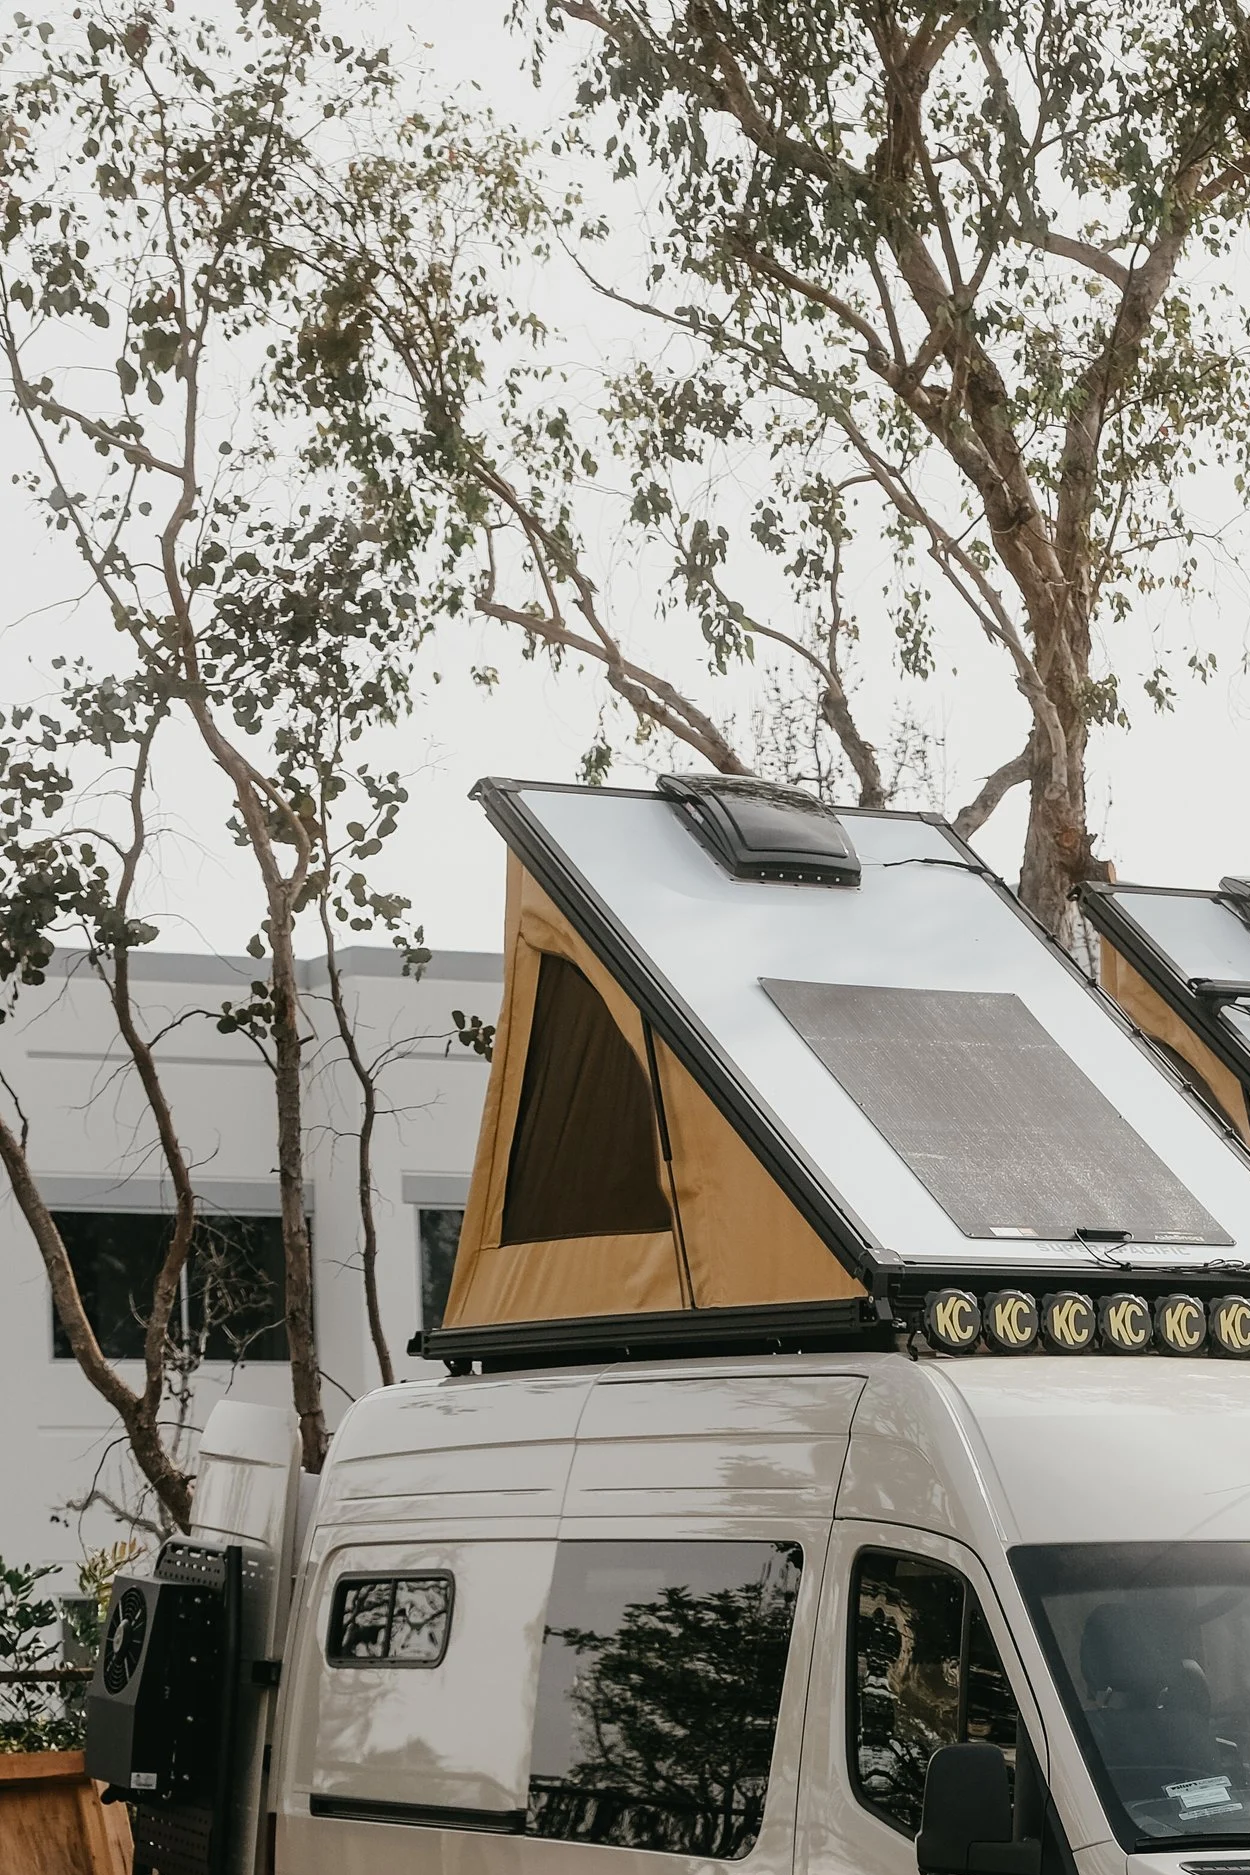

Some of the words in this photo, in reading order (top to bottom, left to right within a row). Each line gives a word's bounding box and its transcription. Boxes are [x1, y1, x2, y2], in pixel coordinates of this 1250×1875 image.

[1036, 1243, 1100, 1254] SUPER
[1117, 1247, 1190, 1256] PACIFIC
[936, 1296, 972, 1342] KC
[994, 1299, 1031, 1344] KC
[1052, 1300, 1088, 1345] KC
[1109, 1302, 1145, 1345] KC
[1165, 1303, 1200, 1347] KC
